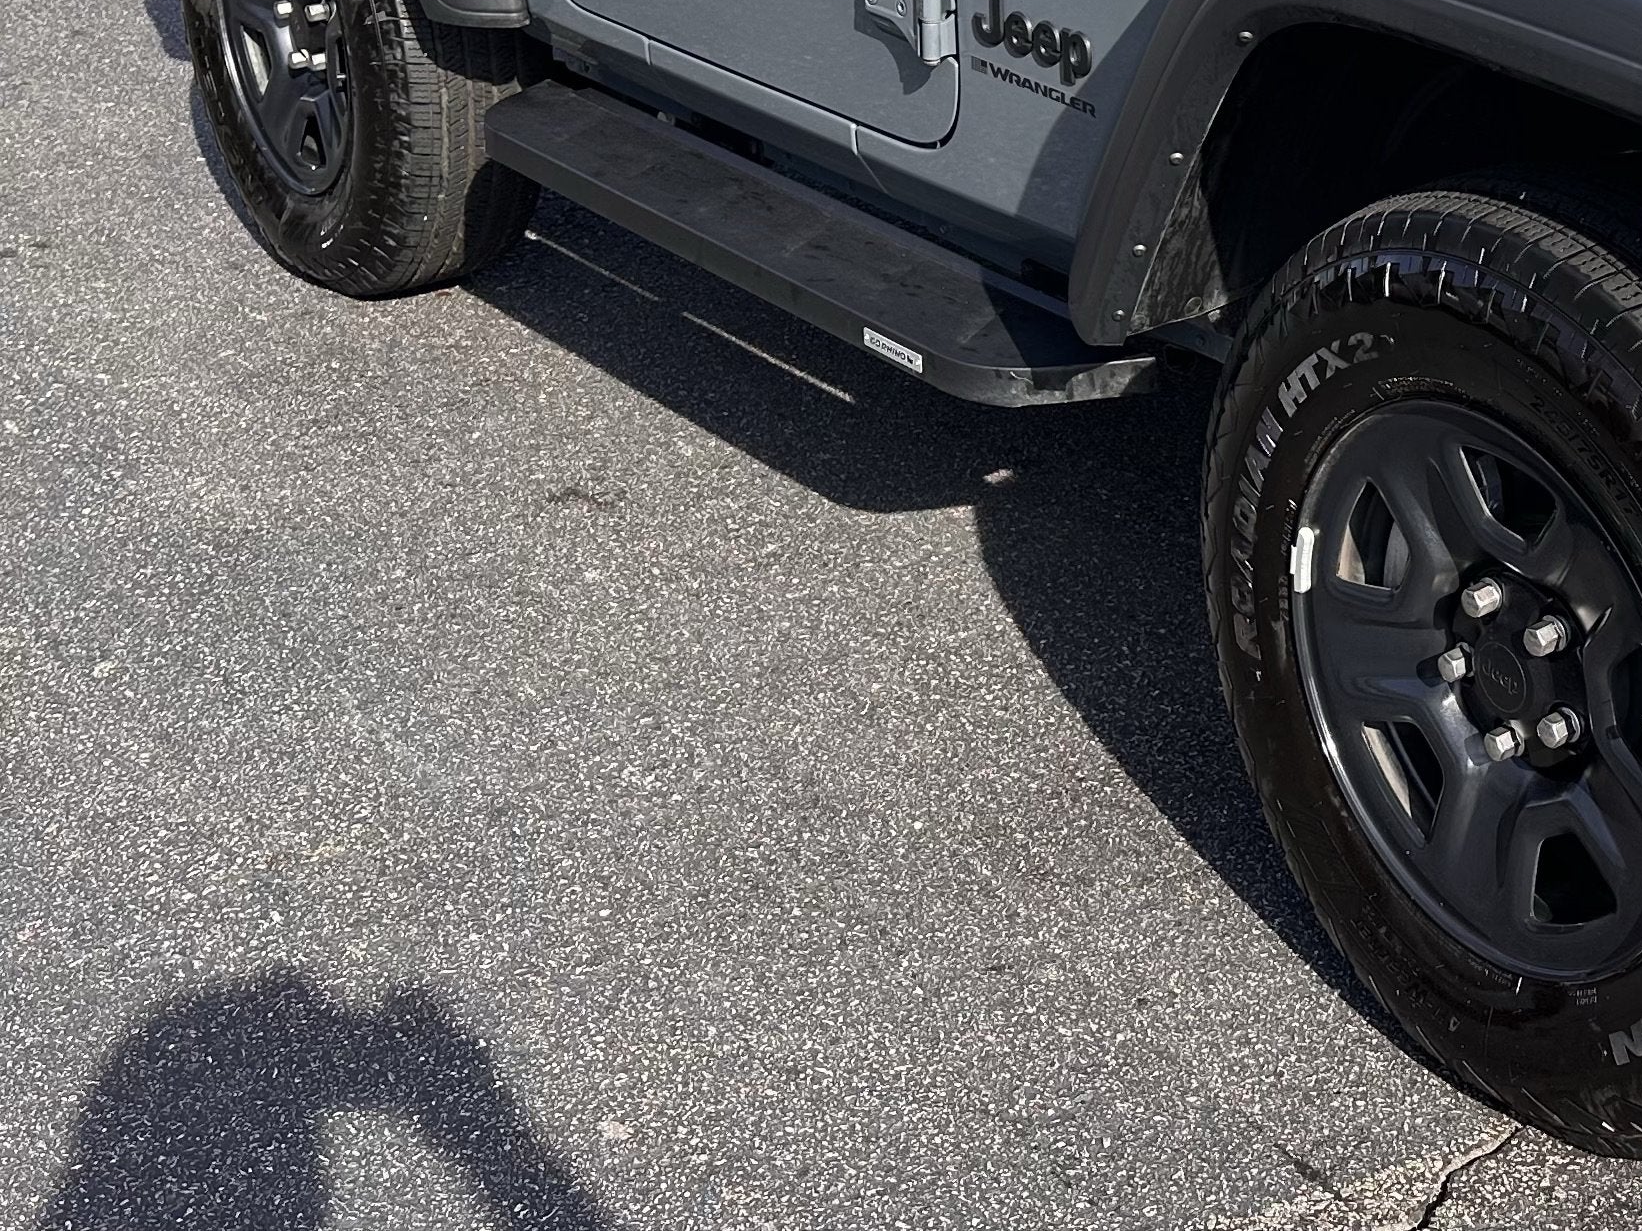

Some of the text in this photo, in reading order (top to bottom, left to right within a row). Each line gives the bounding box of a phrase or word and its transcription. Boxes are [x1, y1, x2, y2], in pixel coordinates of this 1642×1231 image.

[988, 62, 1097, 118] WRANGLER
[869, 336, 906, 360] GO RHINO
[1482, 658, 1518, 695] Jeep
